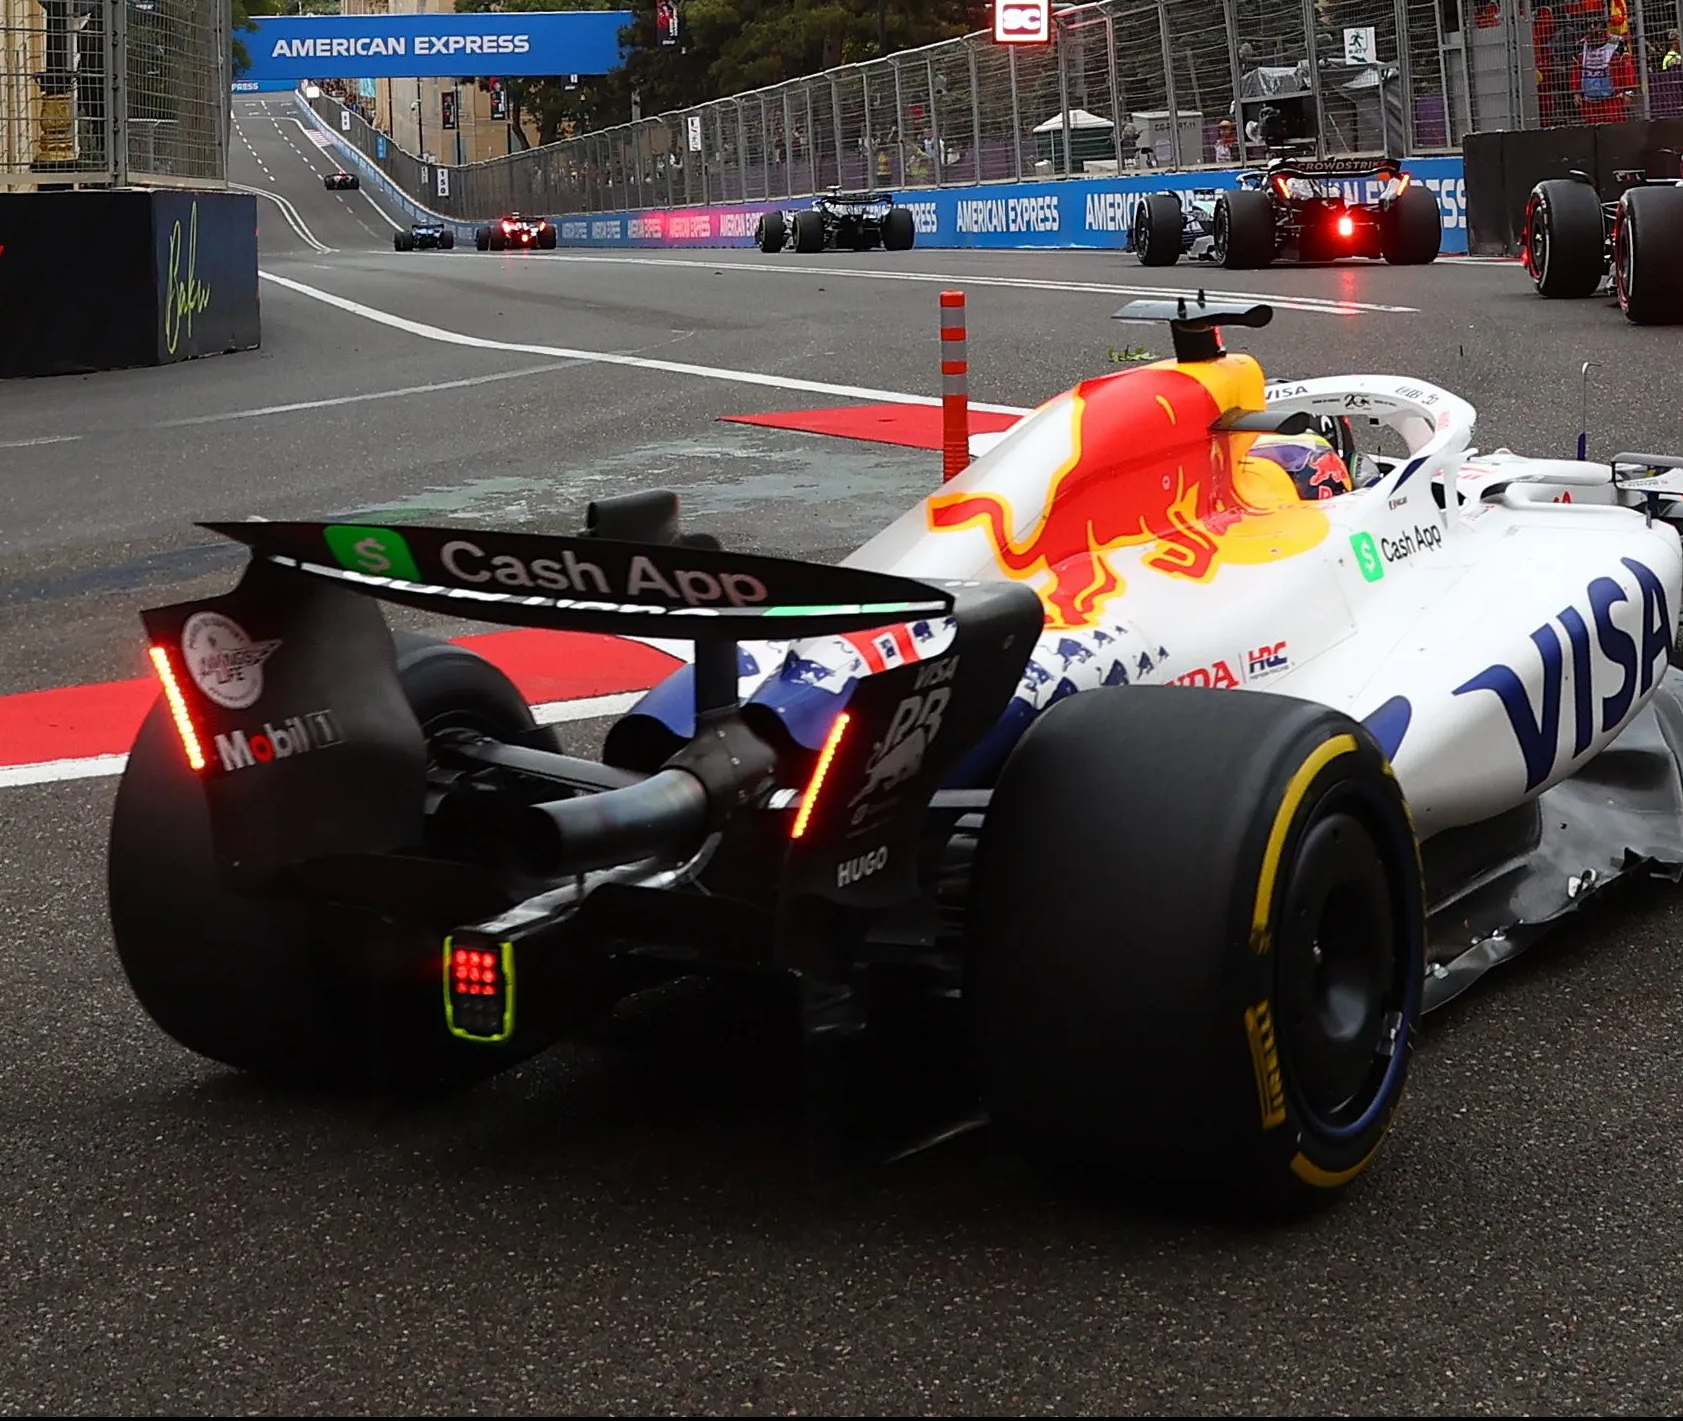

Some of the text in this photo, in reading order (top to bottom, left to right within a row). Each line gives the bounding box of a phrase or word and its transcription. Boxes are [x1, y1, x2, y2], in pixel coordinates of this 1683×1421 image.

[1003, 8, 1041, 30] SC
[272, 34, 531, 58] AMERICAN EXPRESS
[231, 82, 259, 92] PRESS
[439, 170, 447, 194] 150
[956, 196, 1059, 233] AMERICAN EXPRESS
[1086, 192, 1146, 231] AMERIC
[166, 201, 211, 355] Baku
[1381, 531, 1413, 564] Cash
[1415, 523, 1442, 553] App
[439, 540, 610, 594] Cash
[626, 555, 770, 607] App
[1452, 556, 1676, 793] VISA
[214, 716, 311, 771] Mobil
[836, 845, 889, 888] HUGO
